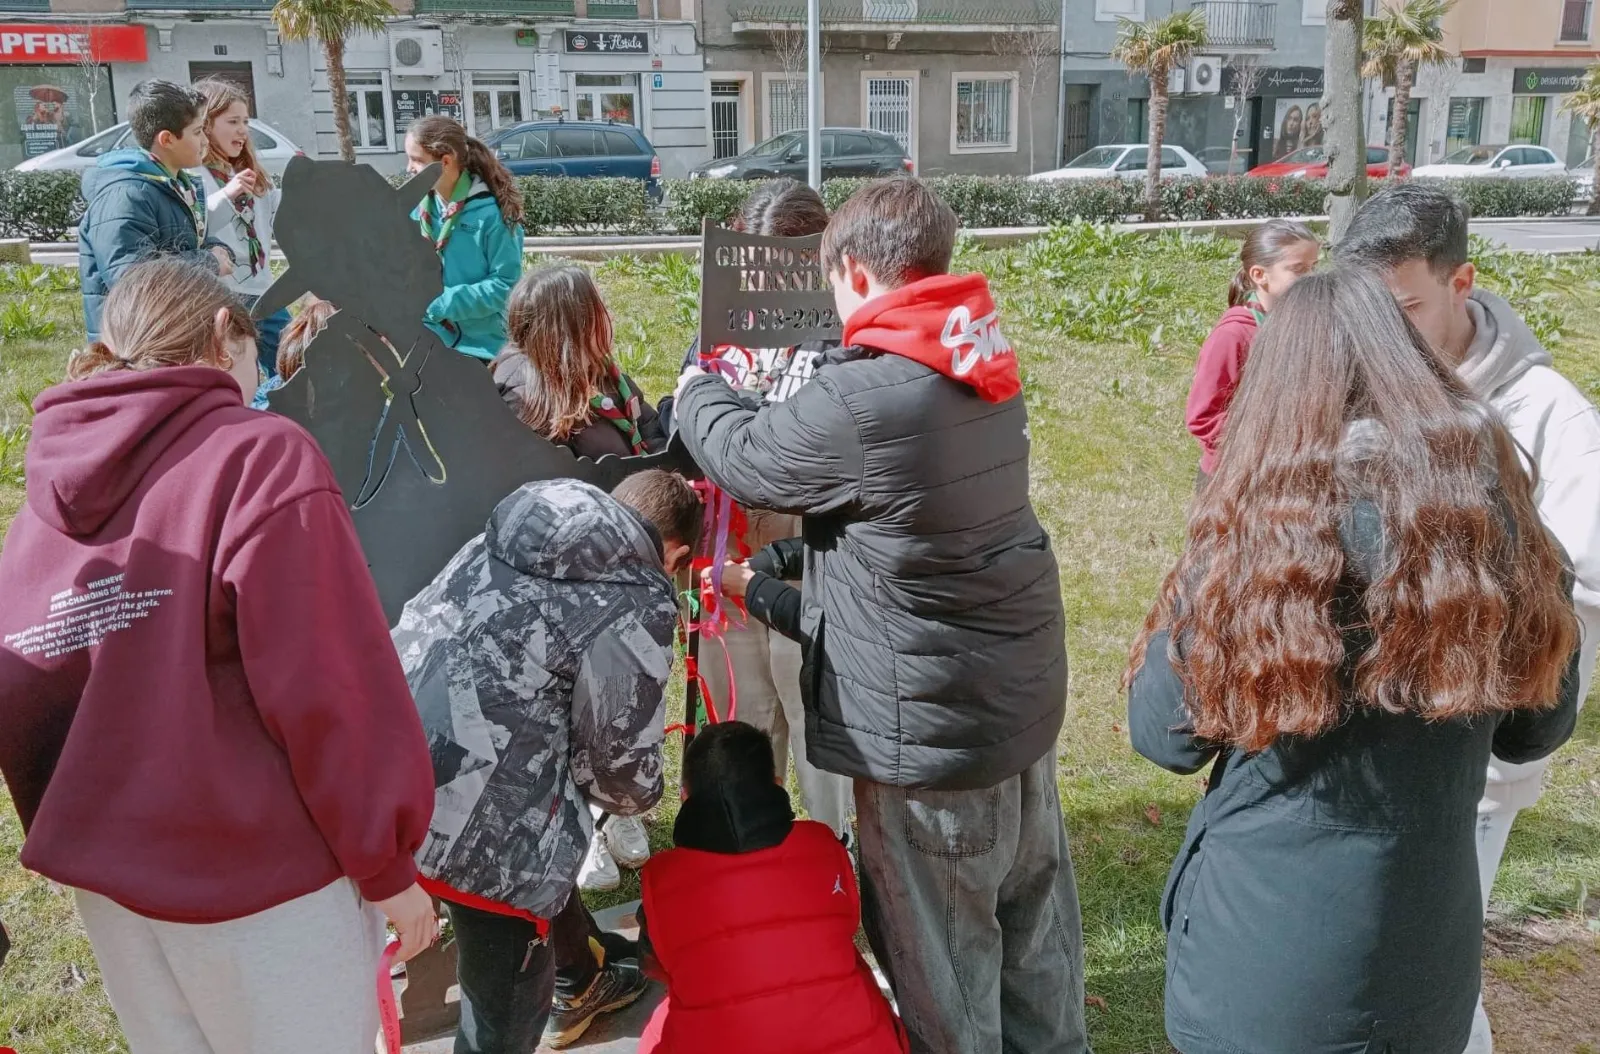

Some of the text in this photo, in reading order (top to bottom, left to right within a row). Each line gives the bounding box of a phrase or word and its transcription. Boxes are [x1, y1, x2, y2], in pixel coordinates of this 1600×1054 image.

[0, 33, 90, 54] PFRE
[609, 33, 642, 50] Florida
[715, 245, 794, 267] GRUPO
[727, 307, 844, 331] 1973-202
[119, 591, 136, 600] like
[120, 601, 135, 610] the
[117, 610, 149, 621] classic
[45, 631, 57, 640] the
[22, 644, 41, 655] Girls
[42, 641, 56, 650] can
[56, 638, 66, 647] be
[44, 647, 61, 658] and
